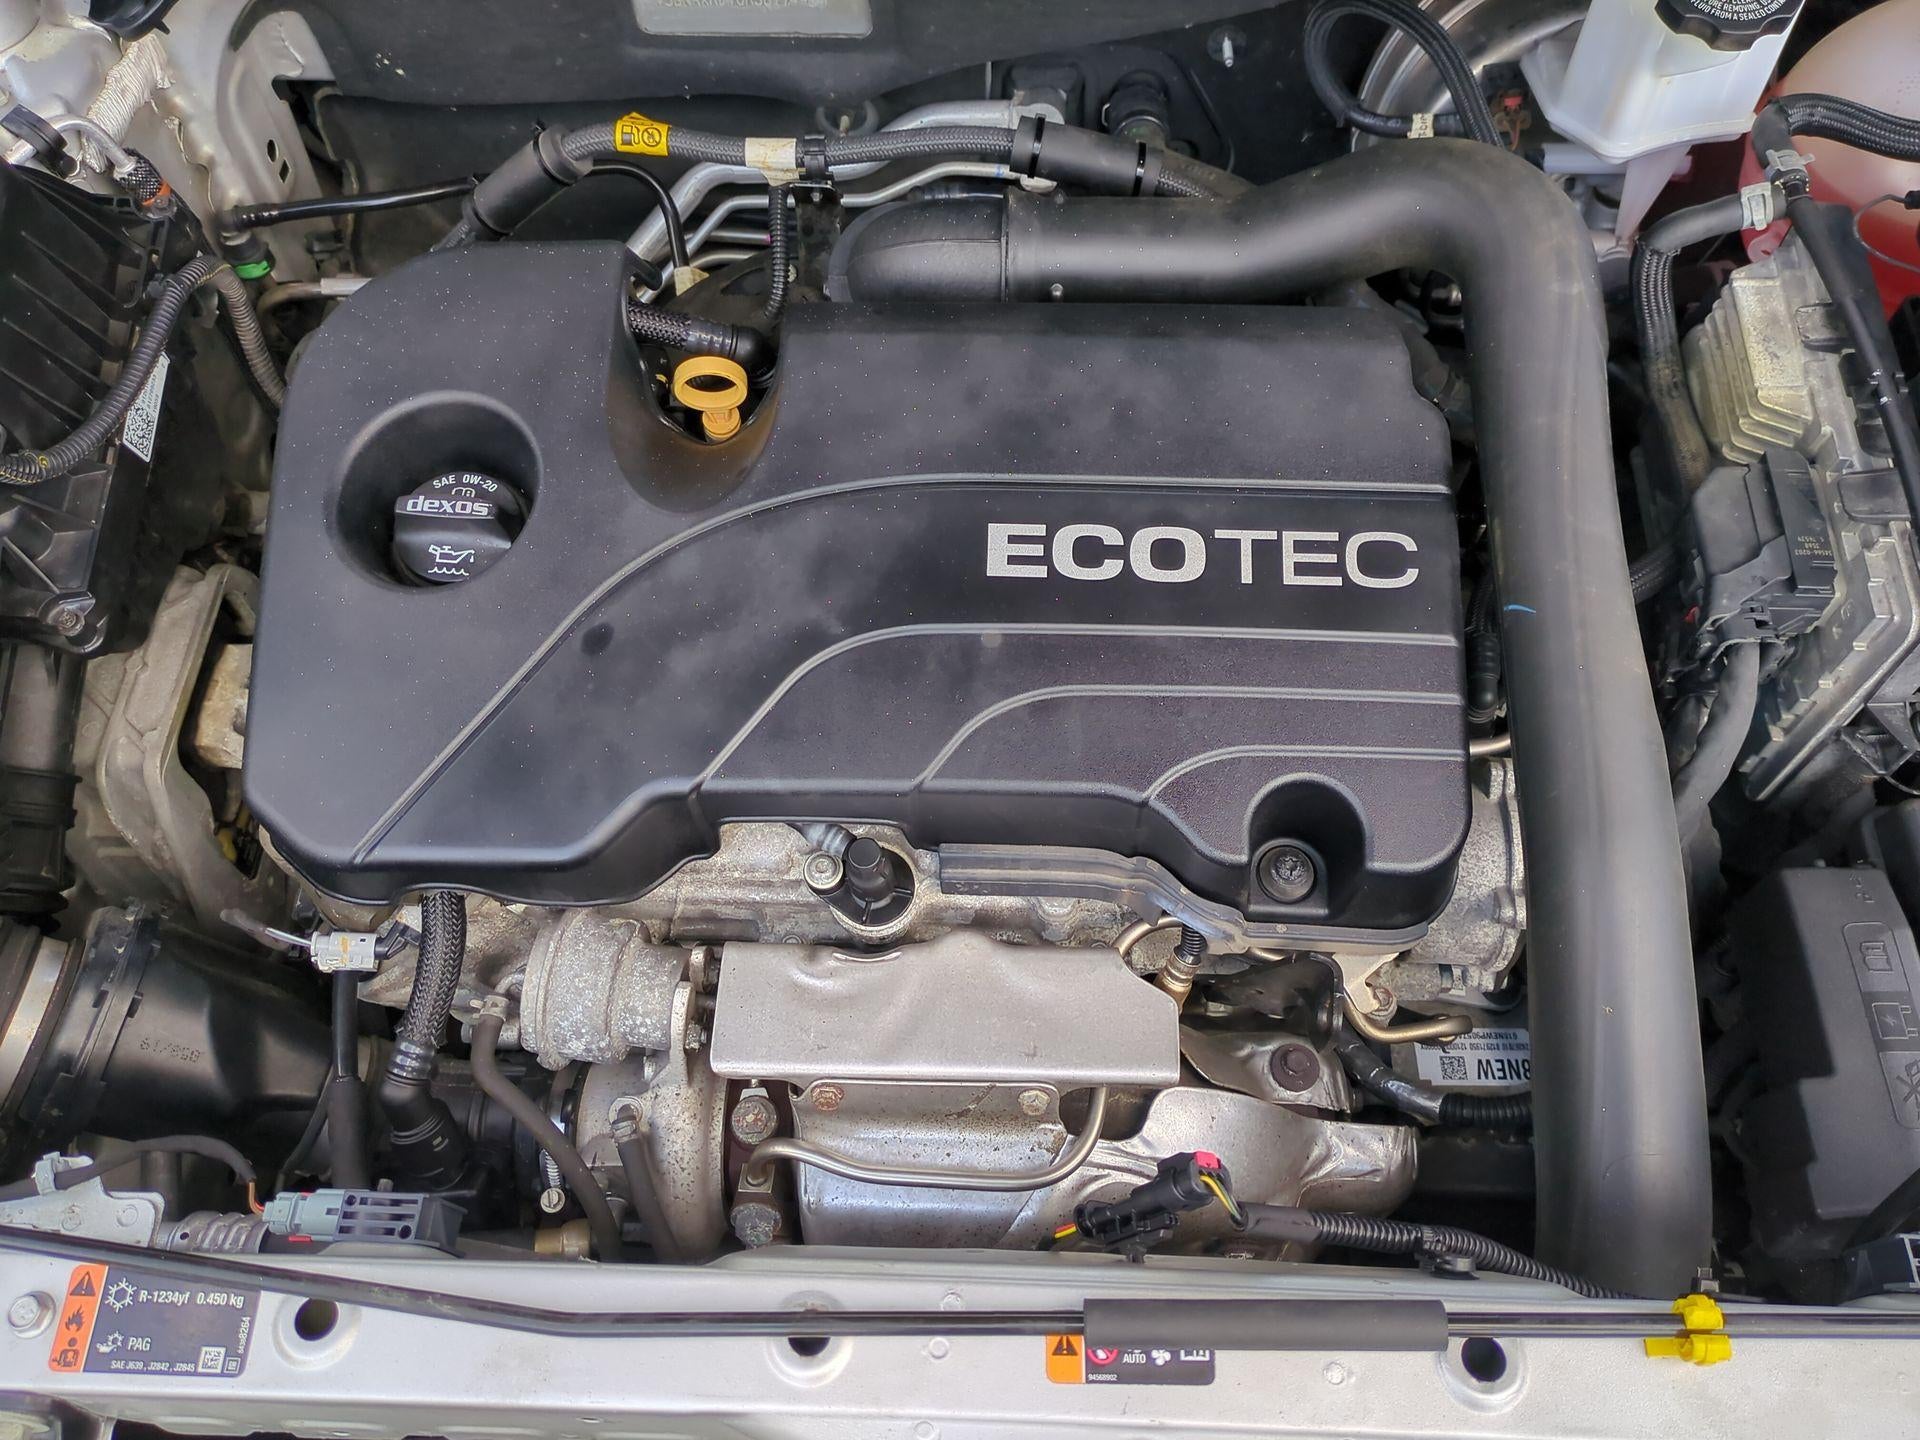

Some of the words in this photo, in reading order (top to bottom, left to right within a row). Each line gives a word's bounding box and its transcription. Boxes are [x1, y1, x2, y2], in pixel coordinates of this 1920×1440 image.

[1710, 8, 1732, 21] FROM
[1733, 13, 1739, 21] A
[1739, 9, 1767, 21] SEALED
[433, 475, 456, 489] SAE
[462, 474, 498, 492] 0W-20
[406, 495, 490, 516] dexos
[986, 523, 1420, 589] ECOTEC
[139, 1290, 190, 1307] R-1234yf
[196, 1291, 228, 1306] 0.450
[230, 1293, 245, 1309] kg
[127, 1337, 152, 1351] PAG
[110, 1360, 126, 1370] SAE
[1122, 1353, 1146, 1364] AUTO
